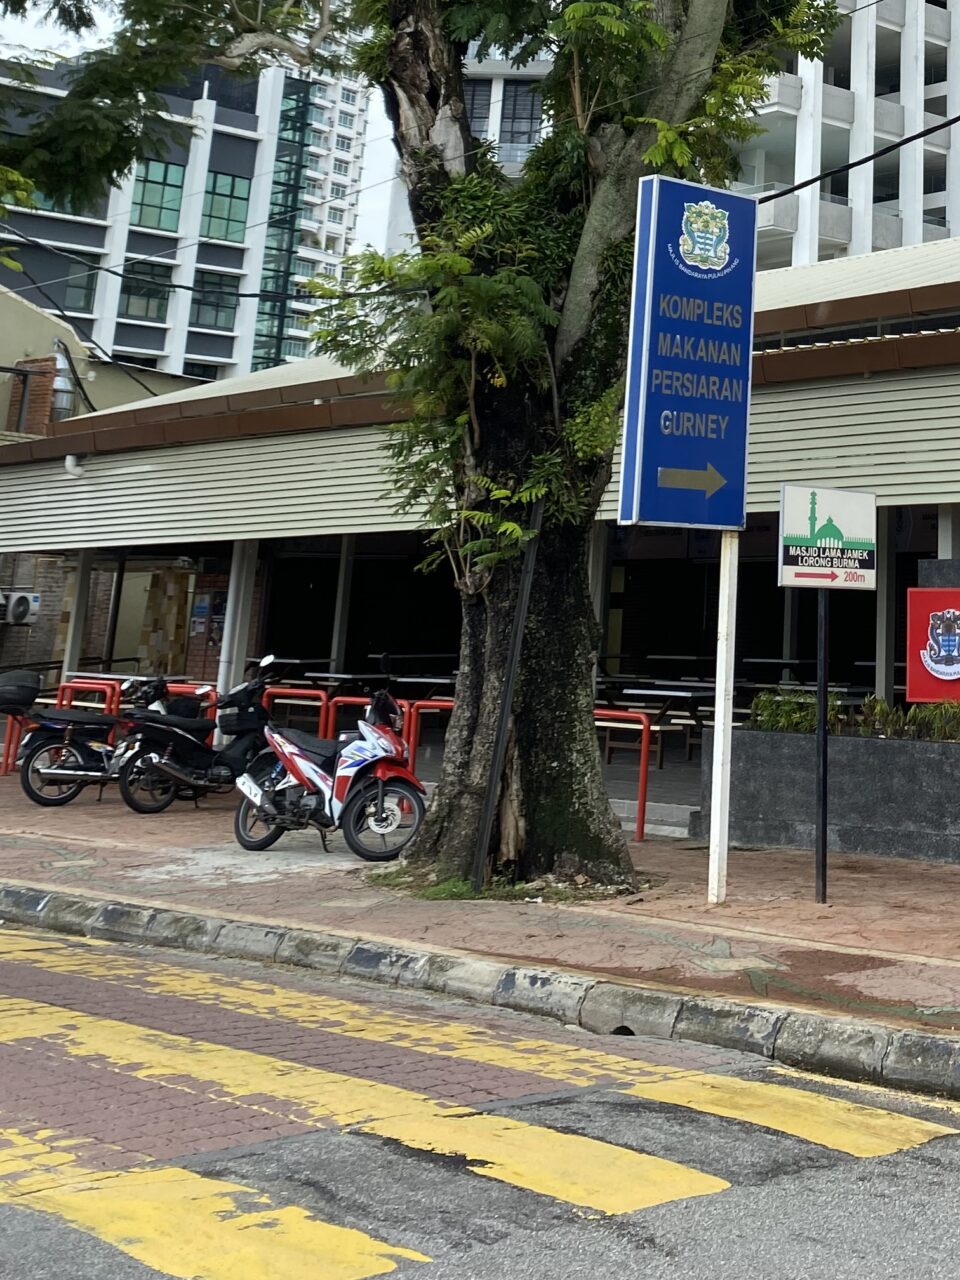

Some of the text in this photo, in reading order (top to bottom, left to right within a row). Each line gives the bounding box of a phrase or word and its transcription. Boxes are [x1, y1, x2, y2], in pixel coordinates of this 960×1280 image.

[659, 293, 743, 328] KOMPLEKS
[657, 332, 741, 366] MAKANAN
[651, 369, 743, 402] PERSIARAN
[660, 410, 729, 439] GURNEY
[789, 546, 868, 560] MASJID LAMA JAMEK
[798, 556, 859, 568] LORONG BURMA
[843, 571, 865, 582] 200m
